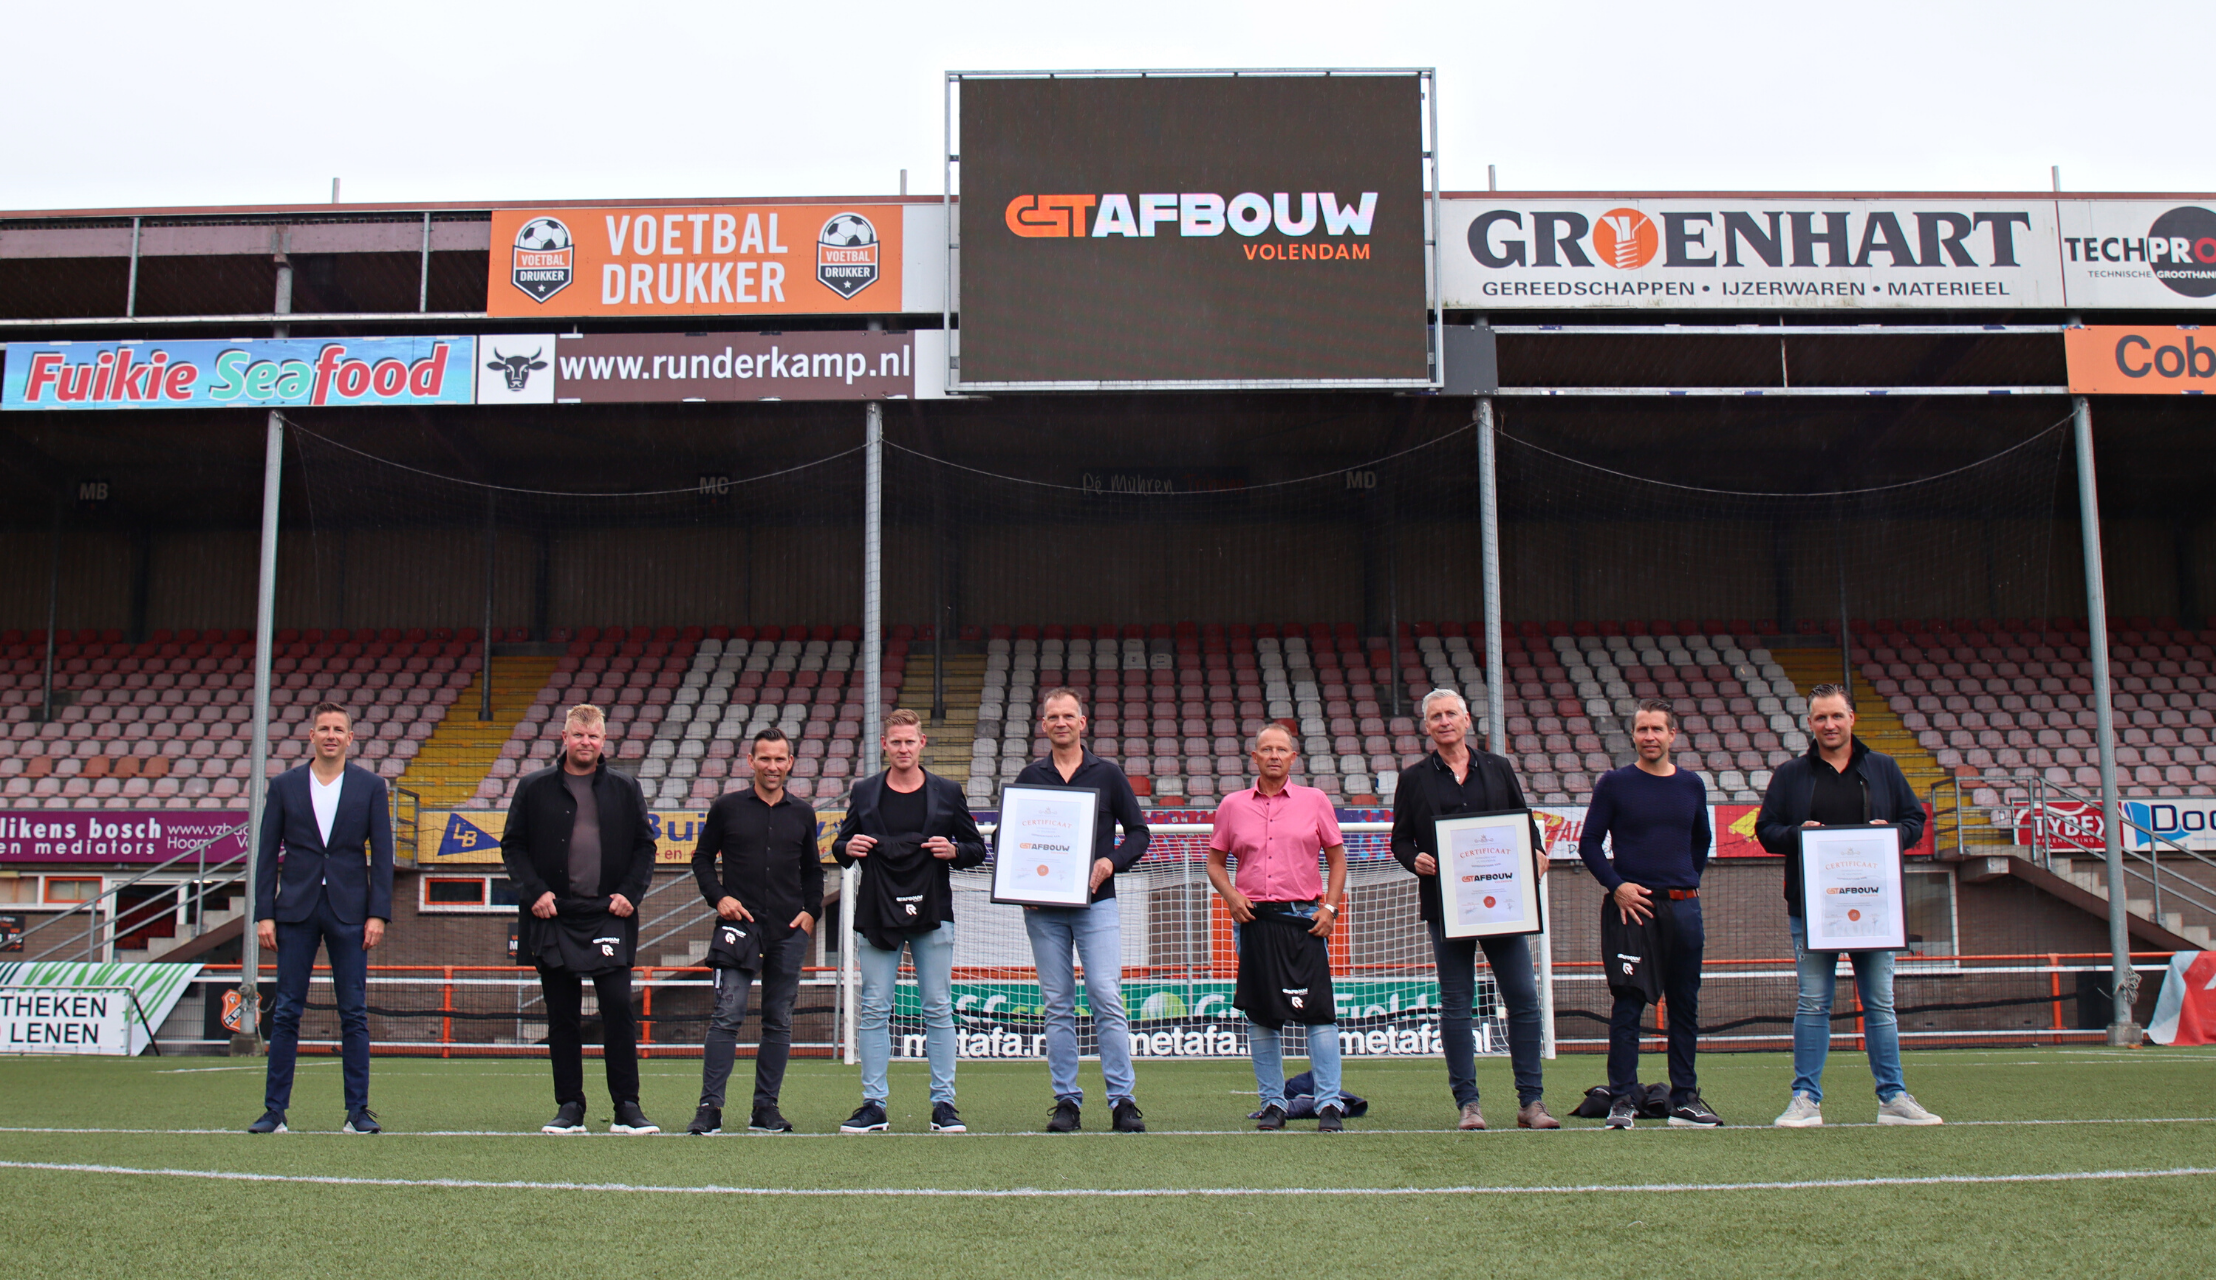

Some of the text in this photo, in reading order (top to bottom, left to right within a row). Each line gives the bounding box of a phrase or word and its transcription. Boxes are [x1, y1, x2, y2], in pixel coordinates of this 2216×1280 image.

[606, 213, 788, 255] VOETBAL
[1467, 207, 2031, 270] GROENHART
[521, 254, 565, 266] VOETBAL
[826, 251, 870, 262] VOETBAL
[1243, 244, 1371, 260] VOLENDAM
[520, 270, 565, 281] DRUKKER
[825, 267, 870, 277] DRUKKER
[2157, 270, 2216, 279] GROOTHAN
[601, 261, 787, 304] DRUKKER
[1482, 281, 2010, 296] GEREEDSCHAPPEN IJZERWAREN MATERIEEL
[559, 345, 911, 384] www.runderkamp.nl
[24, 343, 450, 406] Fuikie Seafood
[700, 477, 729, 494] MC
[1346, 471, 1376, 489] MD
[80, 483, 108, 500] MB
[89, 817, 161, 839] bosch
[1022, 819, 1072, 829] CERTIFICAAT
[34, 839, 155, 854] mediators
[1460, 847, 1511, 859] CERTIFICAAT
[1825, 860, 1878, 870] CERTIFICAAT
[10, 1022, 99, 1043] LENEN
